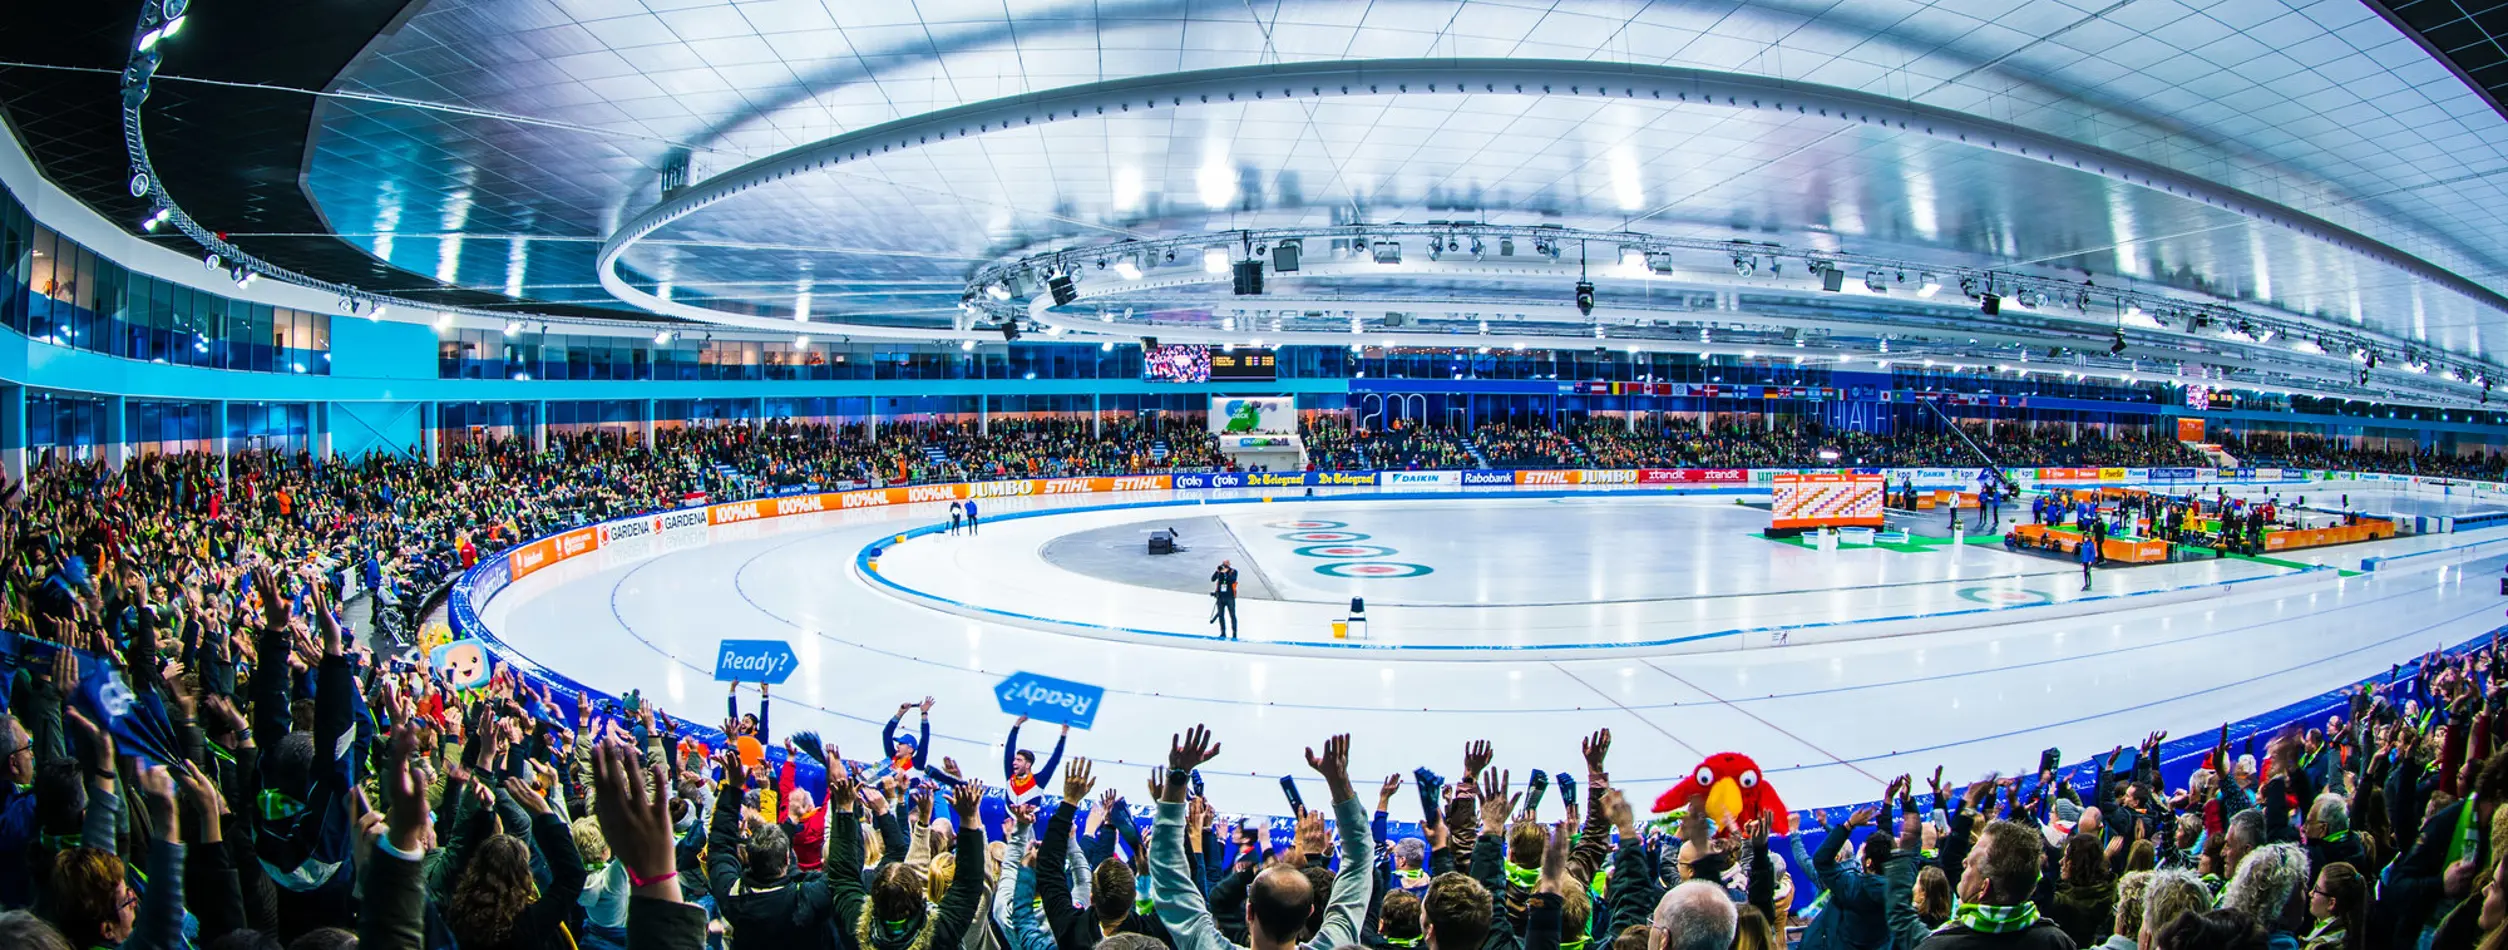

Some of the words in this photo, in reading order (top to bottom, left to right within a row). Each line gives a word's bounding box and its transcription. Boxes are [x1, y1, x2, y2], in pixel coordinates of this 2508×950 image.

[1212, 474, 1239, 487] Croky
[1247, 474, 1262, 486] De
[1263, 473, 1306, 487] Telegraaf
[1318, 473, 1332, 485] De
[1333, 472, 1377, 486] Telegraaf
[1402, 474, 1439, 483] DAIKIN
[1464, 471, 1512, 484] Rabobank
[1524, 471, 1569, 484] STIHL
[1580, 470, 1637, 484] JUMBO
[1648, 471, 1685, 480] xtandit
[1704, 470, 1740, 480] xtandit
[1923, 470, 1946, 478] DAIKIN
[1960, 468, 1975, 481] kpn
[2021, 468, 2033, 480] kpn
[1043, 479, 1093, 494] STIHL
[1111, 476, 1162, 491] STIHL
[1176, 475, 1203, 488] Croky
[908, 486, 956, 502] 100%NL
[968, 480, 1033, 498] JUMBO
[777, 495, 824, 515] 100%NL
[842, 490, 889, 508] 100%NL
[716, 502, 760, 523] 100%NL
[665, 511, 707, 529] GARDENA
[611, 521, 650, 540] GARDENA
[722, 651, 789, 676] Ready?
[1003, 680, 1093, 716] Ready?
